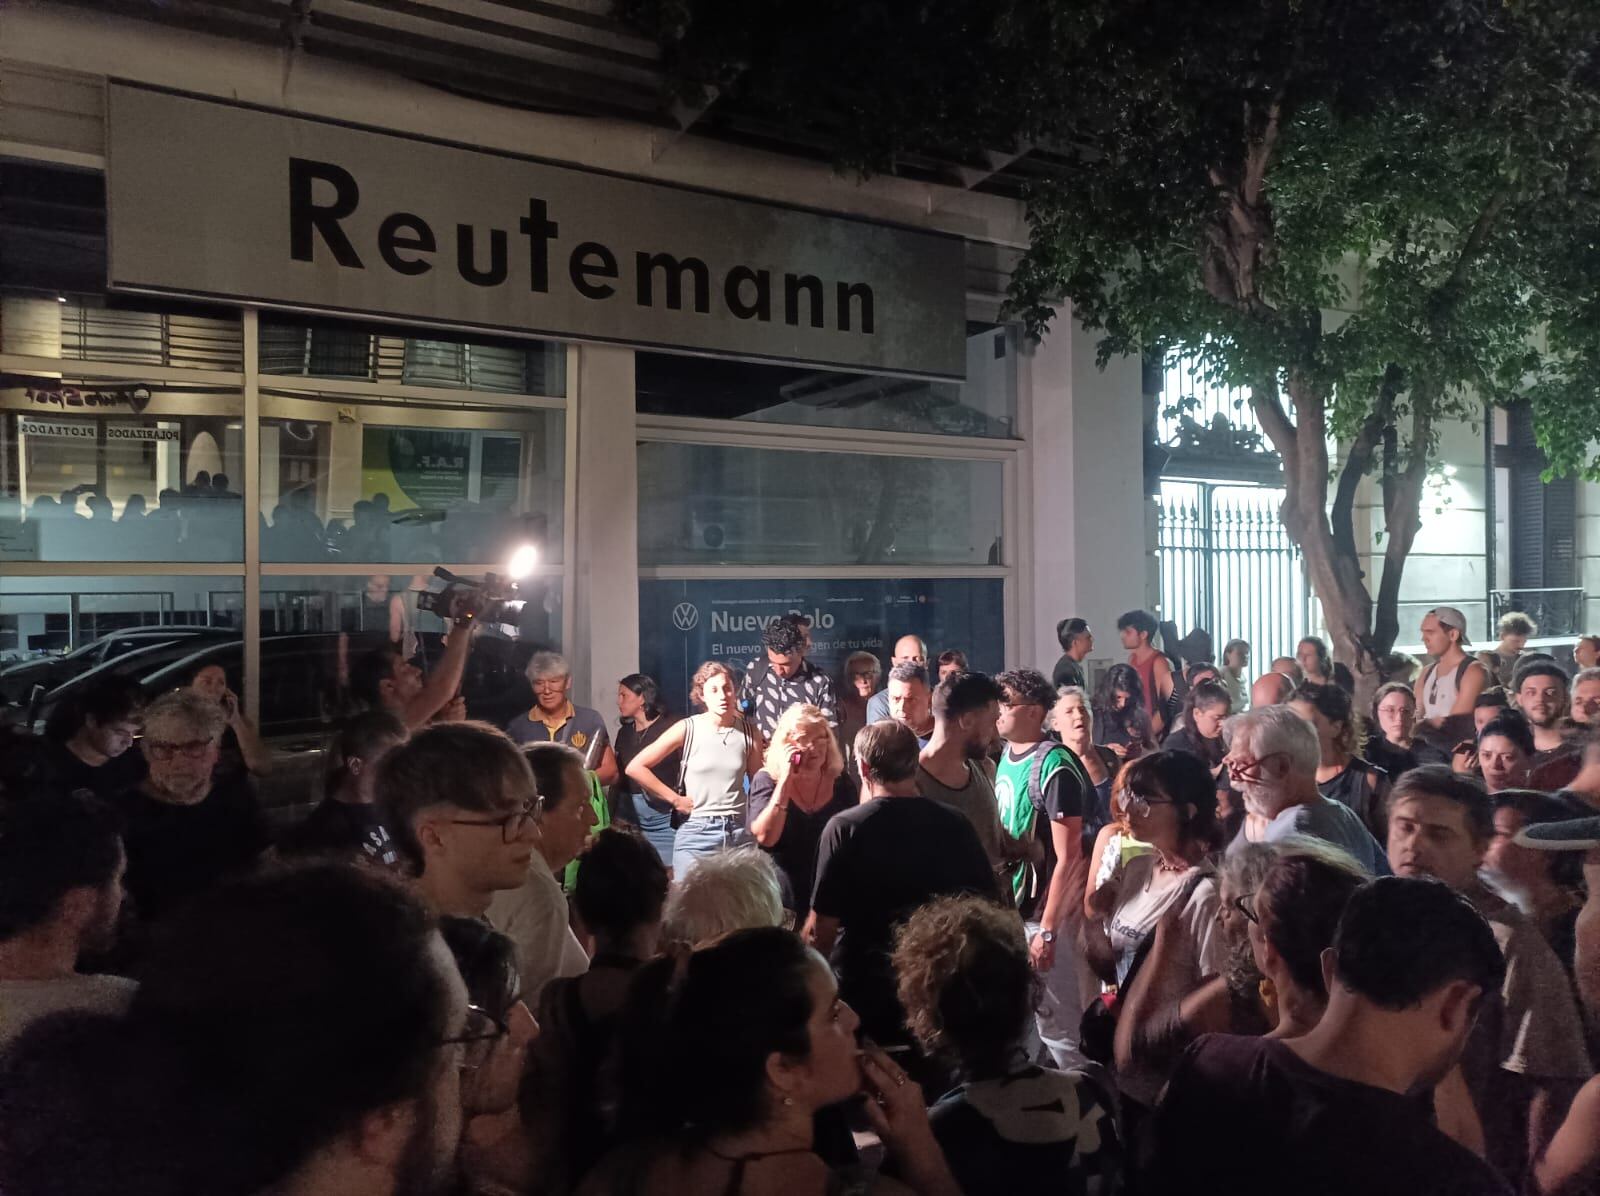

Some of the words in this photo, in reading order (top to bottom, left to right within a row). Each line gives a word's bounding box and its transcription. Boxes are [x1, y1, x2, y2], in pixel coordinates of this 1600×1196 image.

[289, 157, 875, 334] Reutemann
[788, 608, 834, 629] olo
[712, 643, 723, 655] El
[726, 645, 761, 654] nuevo
[833, 640, 845, 648] de
[848, 640, 859, 648] tu
[861, 637, 883, 648] vida
